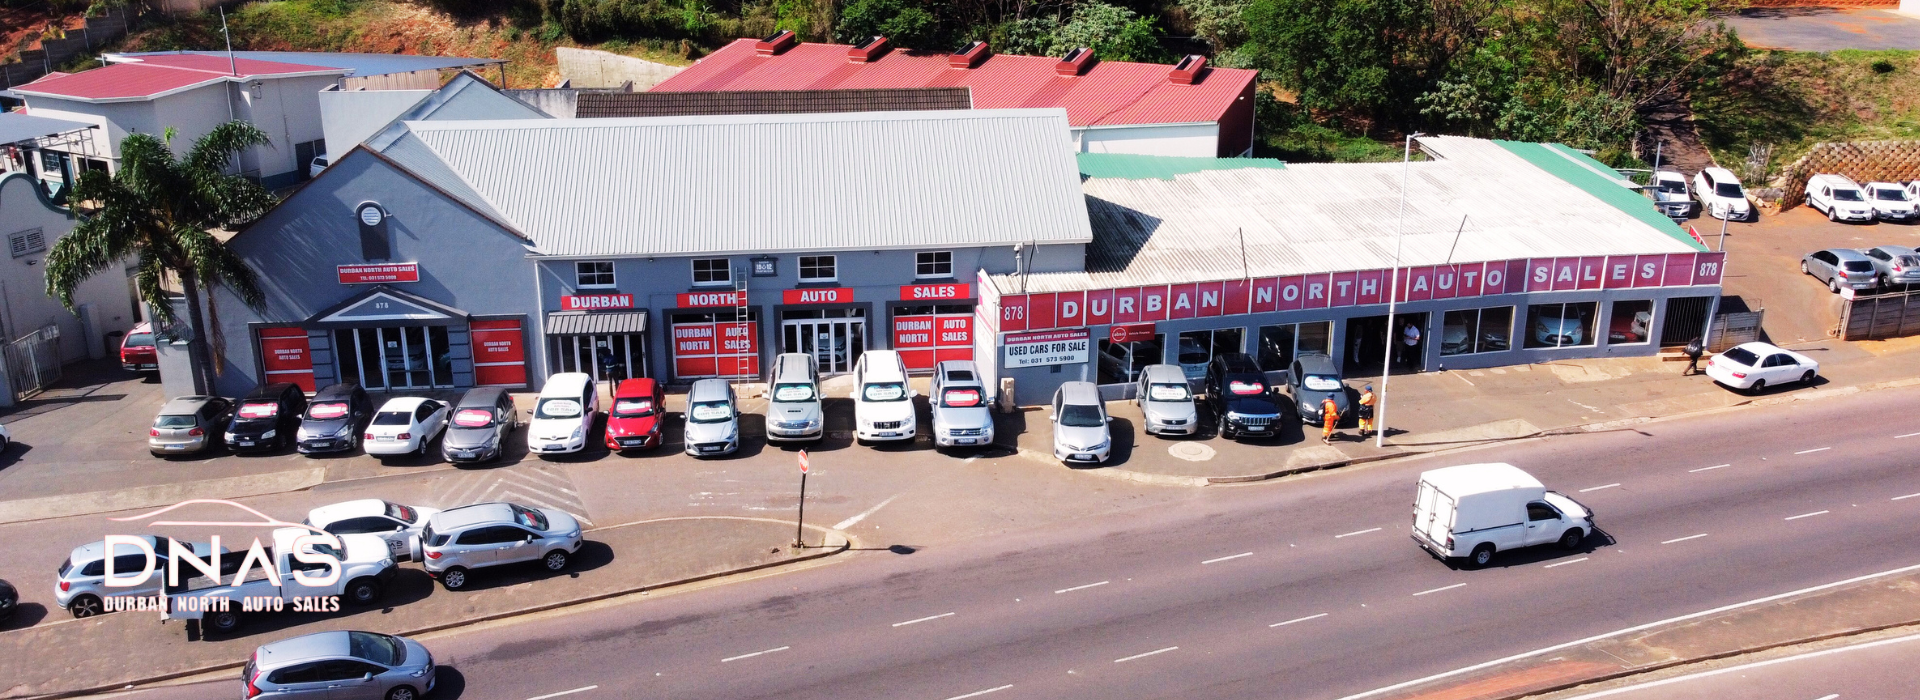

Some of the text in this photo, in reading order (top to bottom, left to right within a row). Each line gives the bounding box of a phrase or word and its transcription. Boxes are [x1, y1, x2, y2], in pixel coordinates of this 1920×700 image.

[1699, 262, 1717, 277] 878
[801, 290, 837, 302] AUTO
[914, 286, 955, 298] SALES
[1062, 263, 1655, 319] DURBAN NORTH AUTO SALES
[571, 296, 629, 308] DURBAN
[689, 294, 737, 305] NORTH
[1004, 306, 1024, 321] 878
[896, 320, 932, 331] DURBAN
[943, 319, 966, 329] AUTO
[676, 328, 712, 338] DURBAN
[899, 332, 928, 343] NORTH
[942, 331, 967, 342] SALES
[680, 341, 710, 350] NORTH
[1009, 341, 1086, 356] USED CARS FOR SALE
